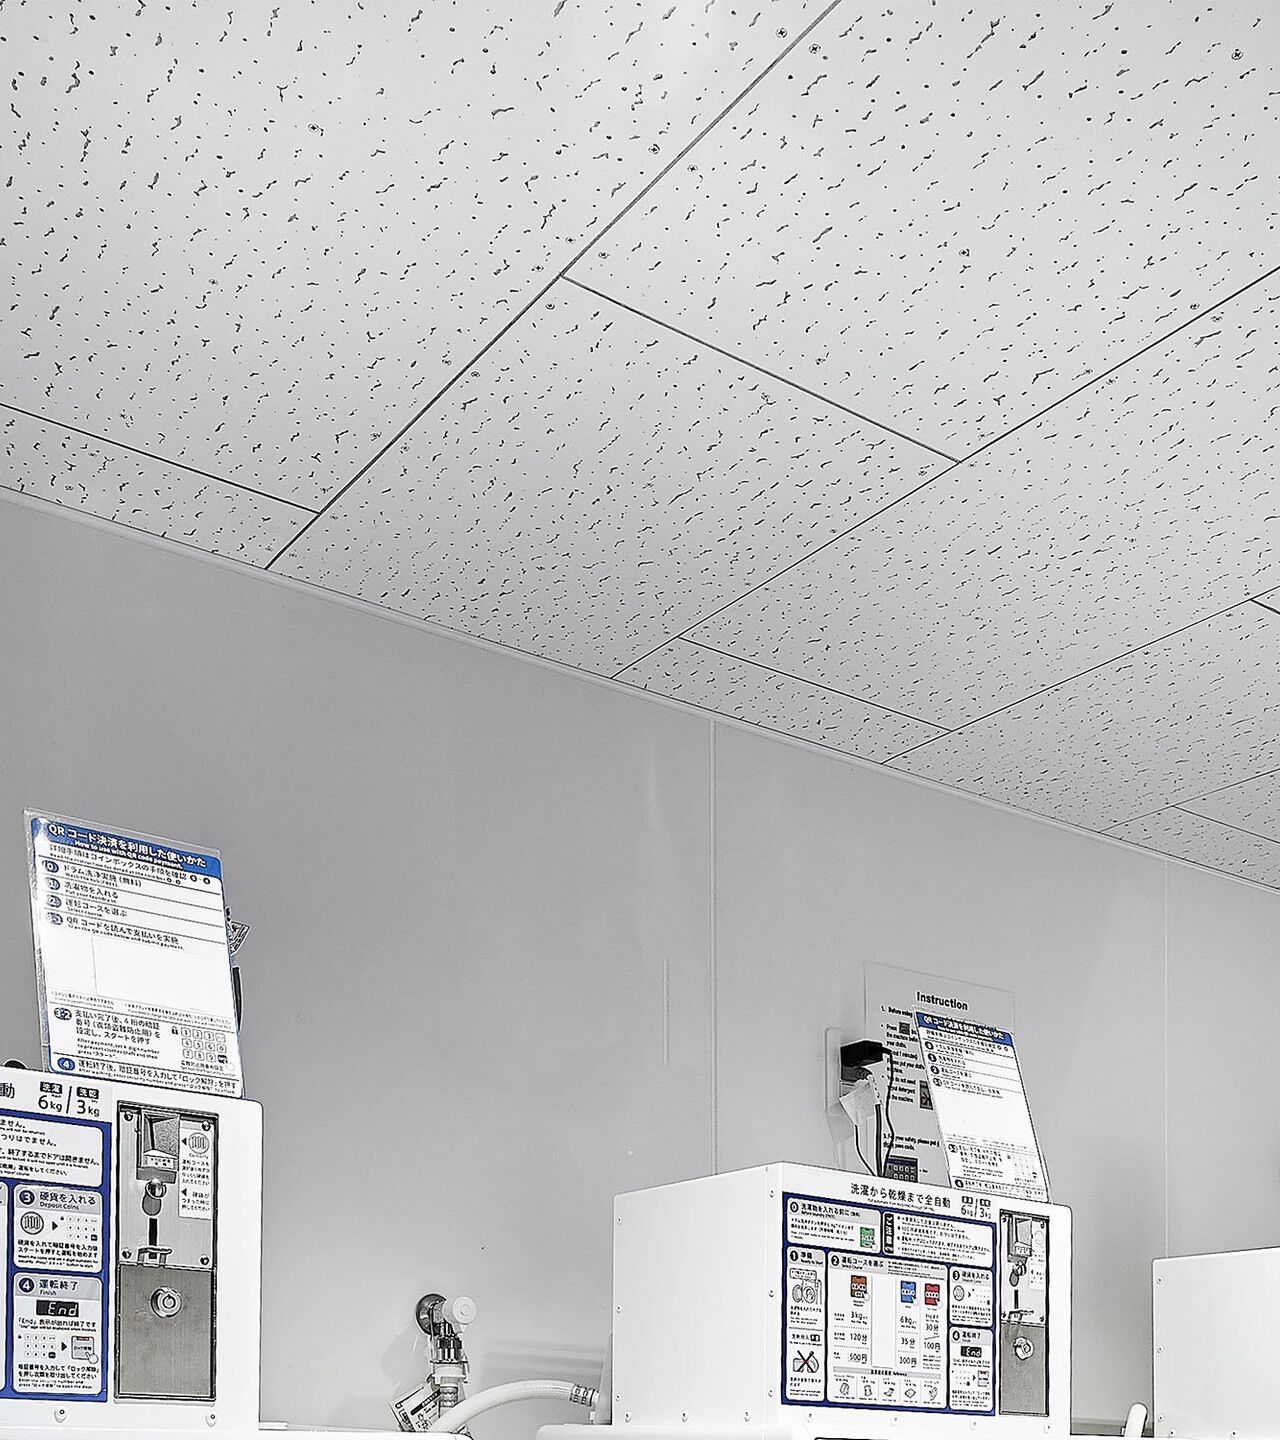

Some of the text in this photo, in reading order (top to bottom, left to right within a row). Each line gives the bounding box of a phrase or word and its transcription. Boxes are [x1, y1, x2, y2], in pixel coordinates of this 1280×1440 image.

[916, 992, 968, 1010] Instruction
[40, 1191, 96, 1205] 硬貨を入れる
[851, 1183, 951, 1208] 洗濯から乾燥まで全自動
[40, 1201, 63, 1209] Deposit
[39, 1280, 78, 1291] 運転終了
[48, 1302, 77, 1316] End
